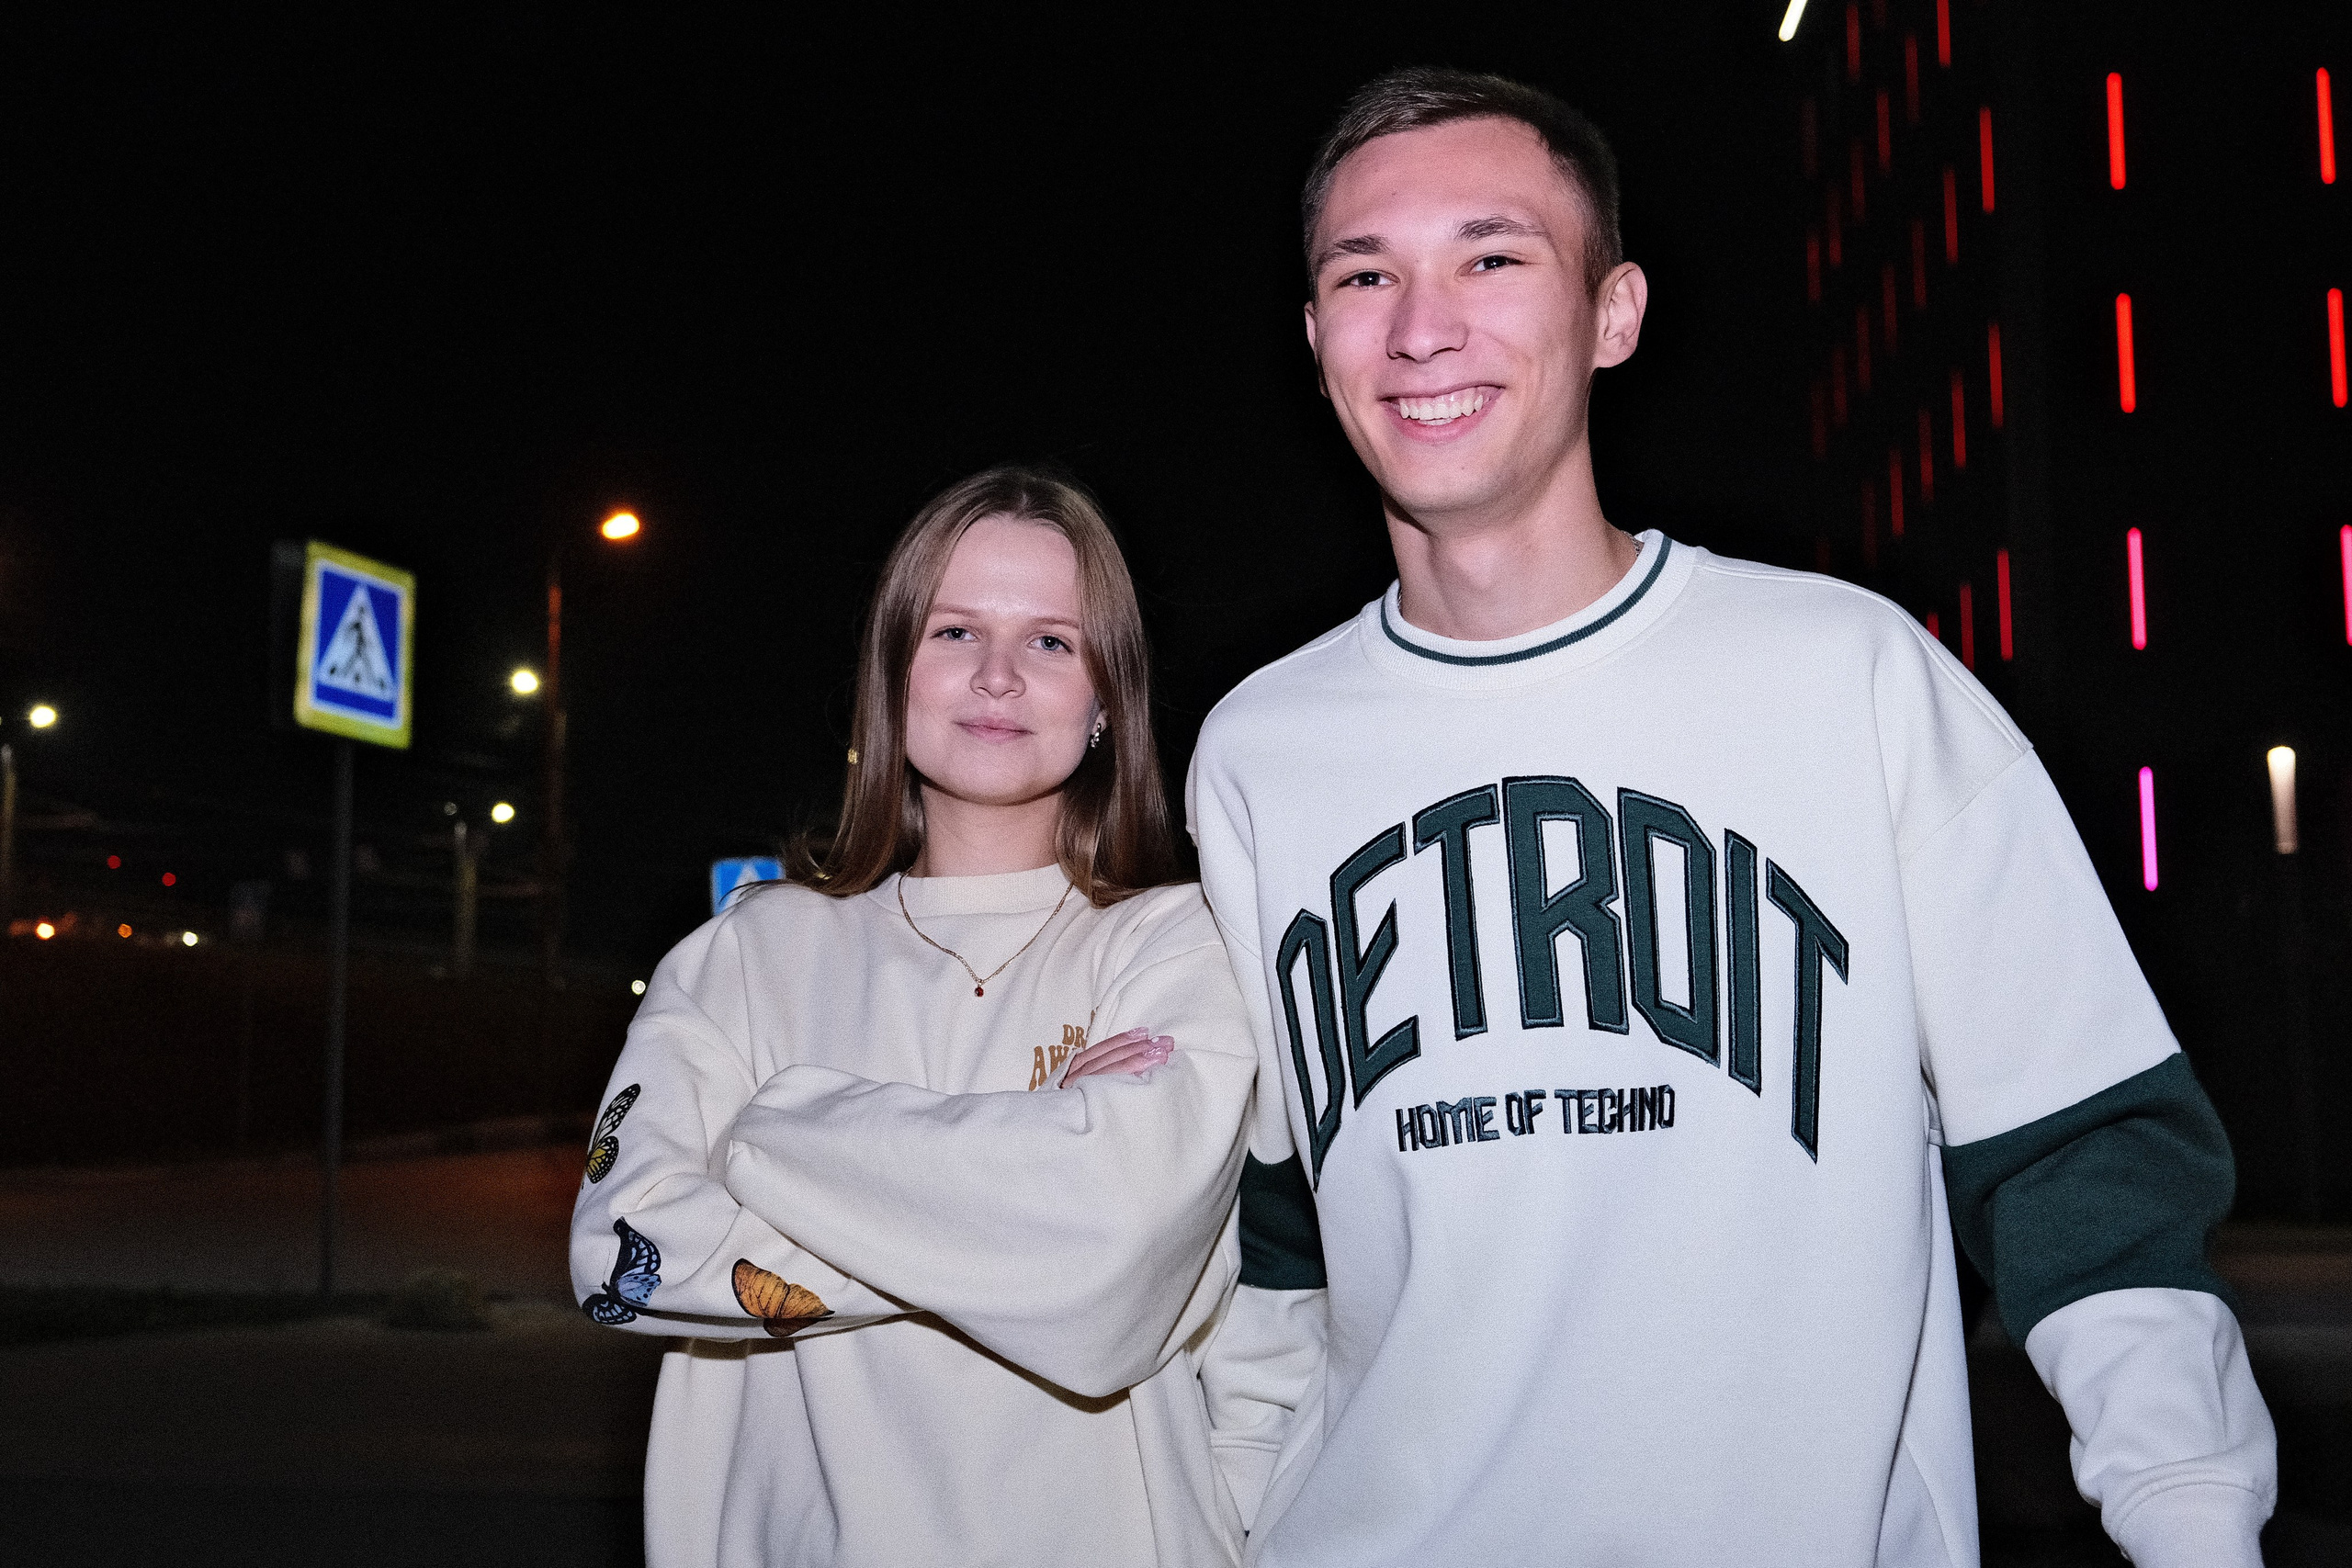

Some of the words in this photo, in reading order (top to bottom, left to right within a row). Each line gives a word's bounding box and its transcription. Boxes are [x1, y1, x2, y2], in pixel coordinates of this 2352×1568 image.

[1276, 775, 1849, 1193] DETROIT
[1396, 1097, 1500, 1152] HOME
[1505, 1089, 1546, 1136] OF
[1554, 1084, 1675, 1134] TECHNO
